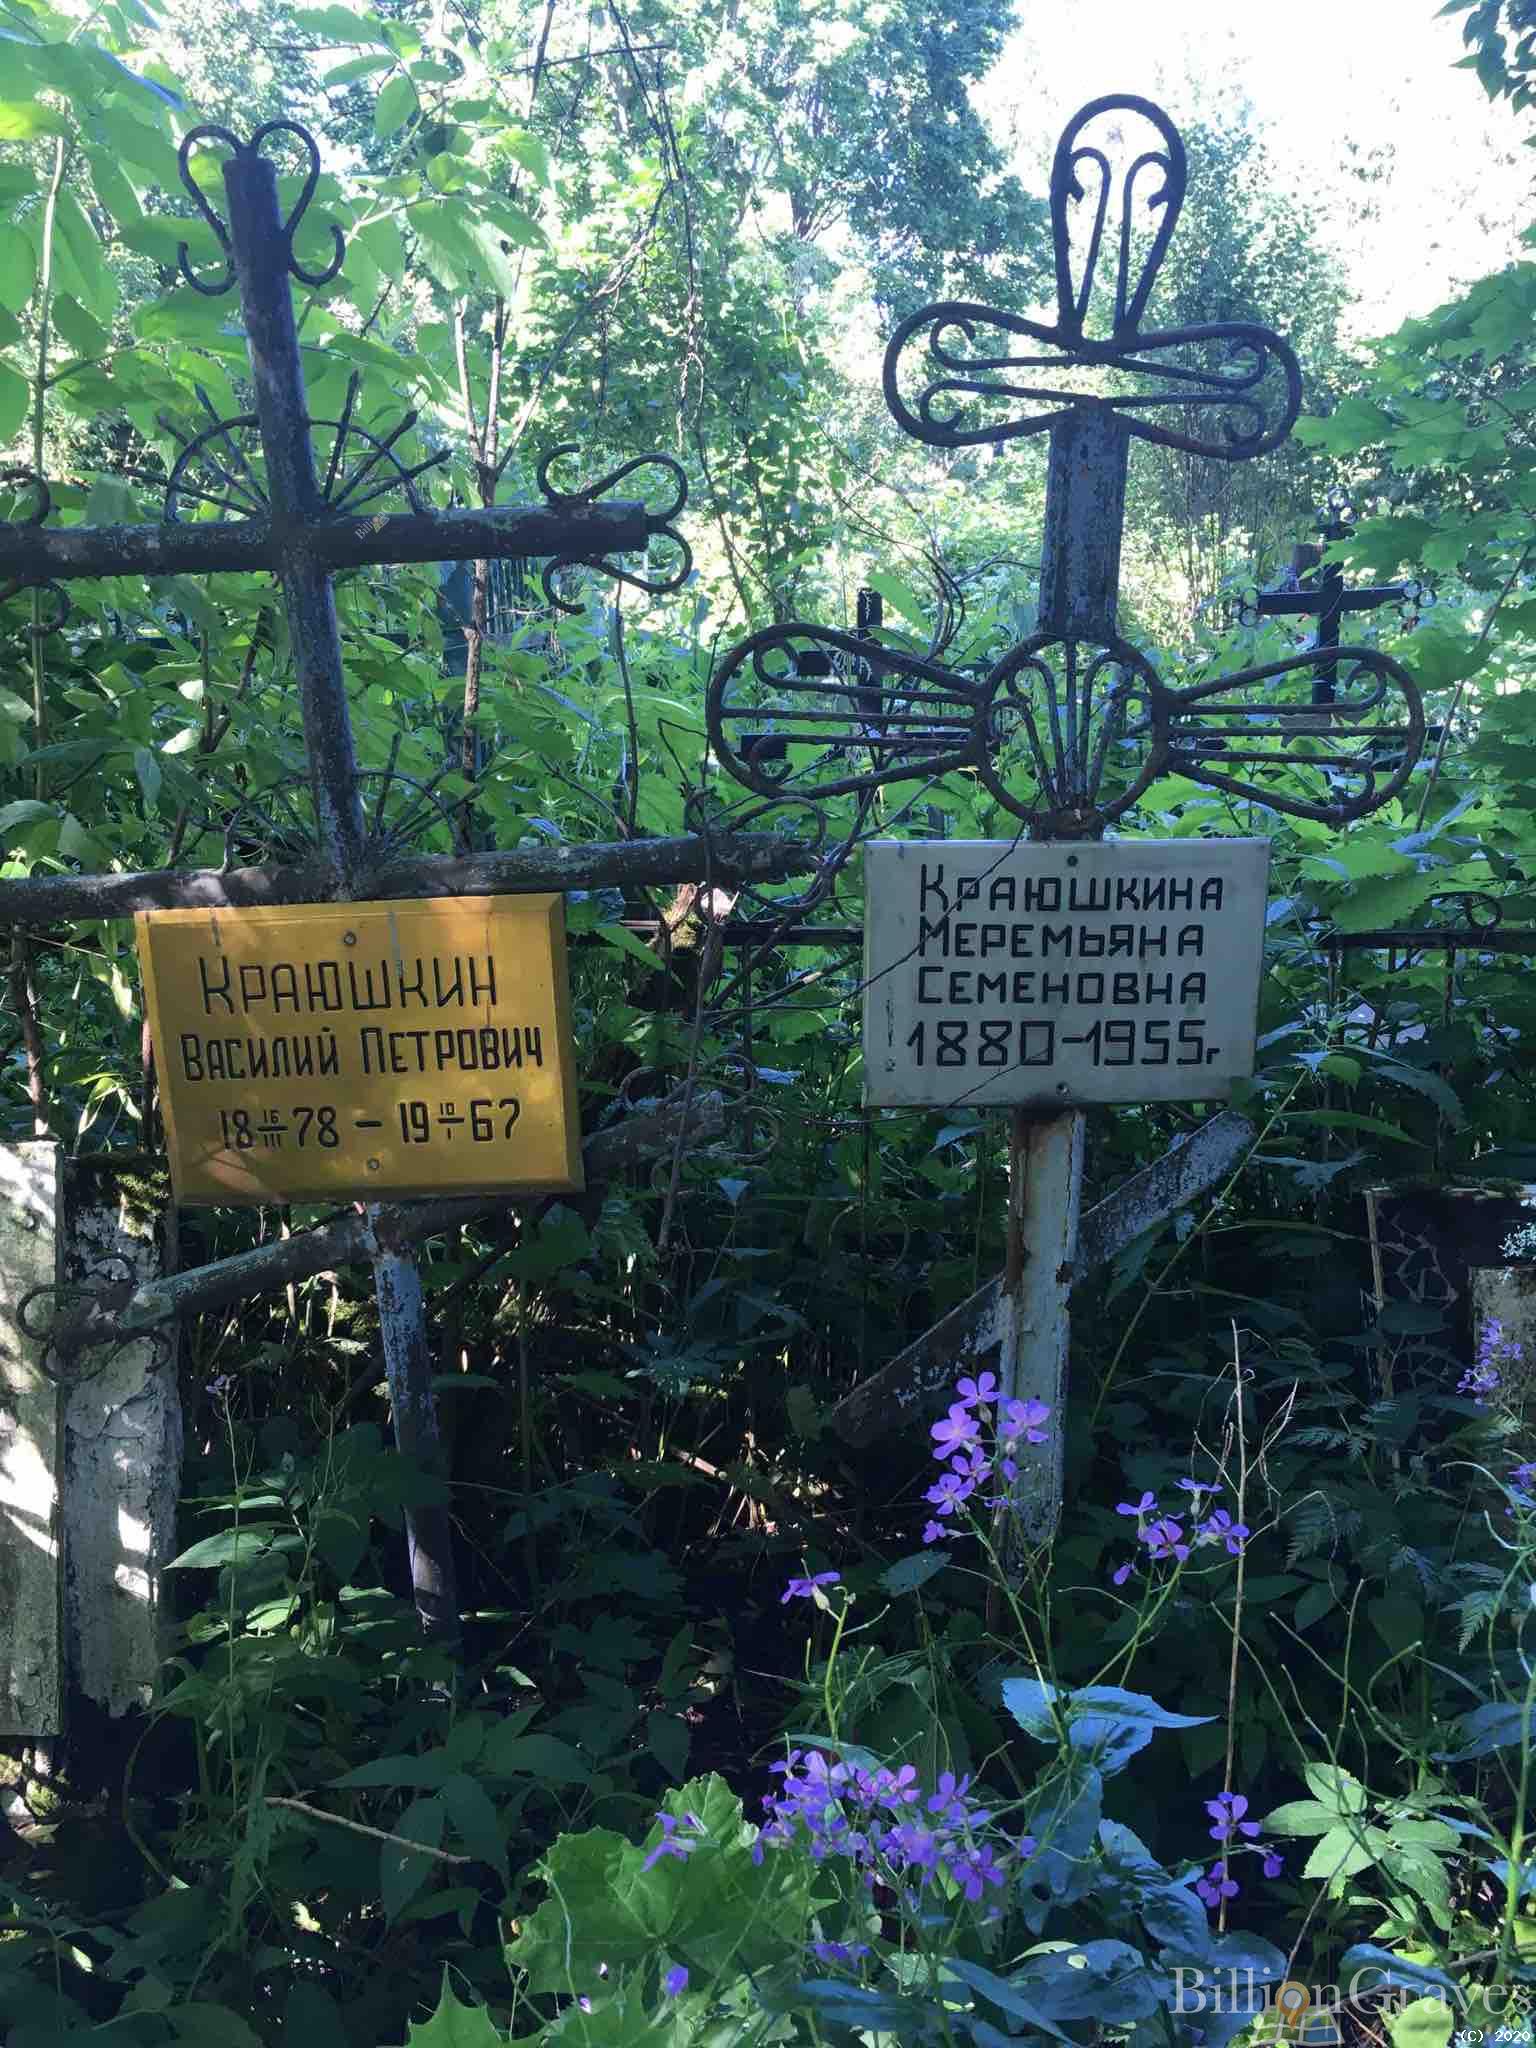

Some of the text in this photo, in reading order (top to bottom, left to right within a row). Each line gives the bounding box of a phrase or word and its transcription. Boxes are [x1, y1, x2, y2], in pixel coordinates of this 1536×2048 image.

[919, 863, 1224, 913] КРАЮШКИНА
[918, 915, 1205, 958] МЕРЕМЬЯНА
[199, 955, 498, 1015] КРАЮШКИН
[917, 966, 1207, 1006] СЕМЕНОВНА
[180, 1025, 544, 1082] ВАСИЛИЙ ПЕТРОВИЧ
